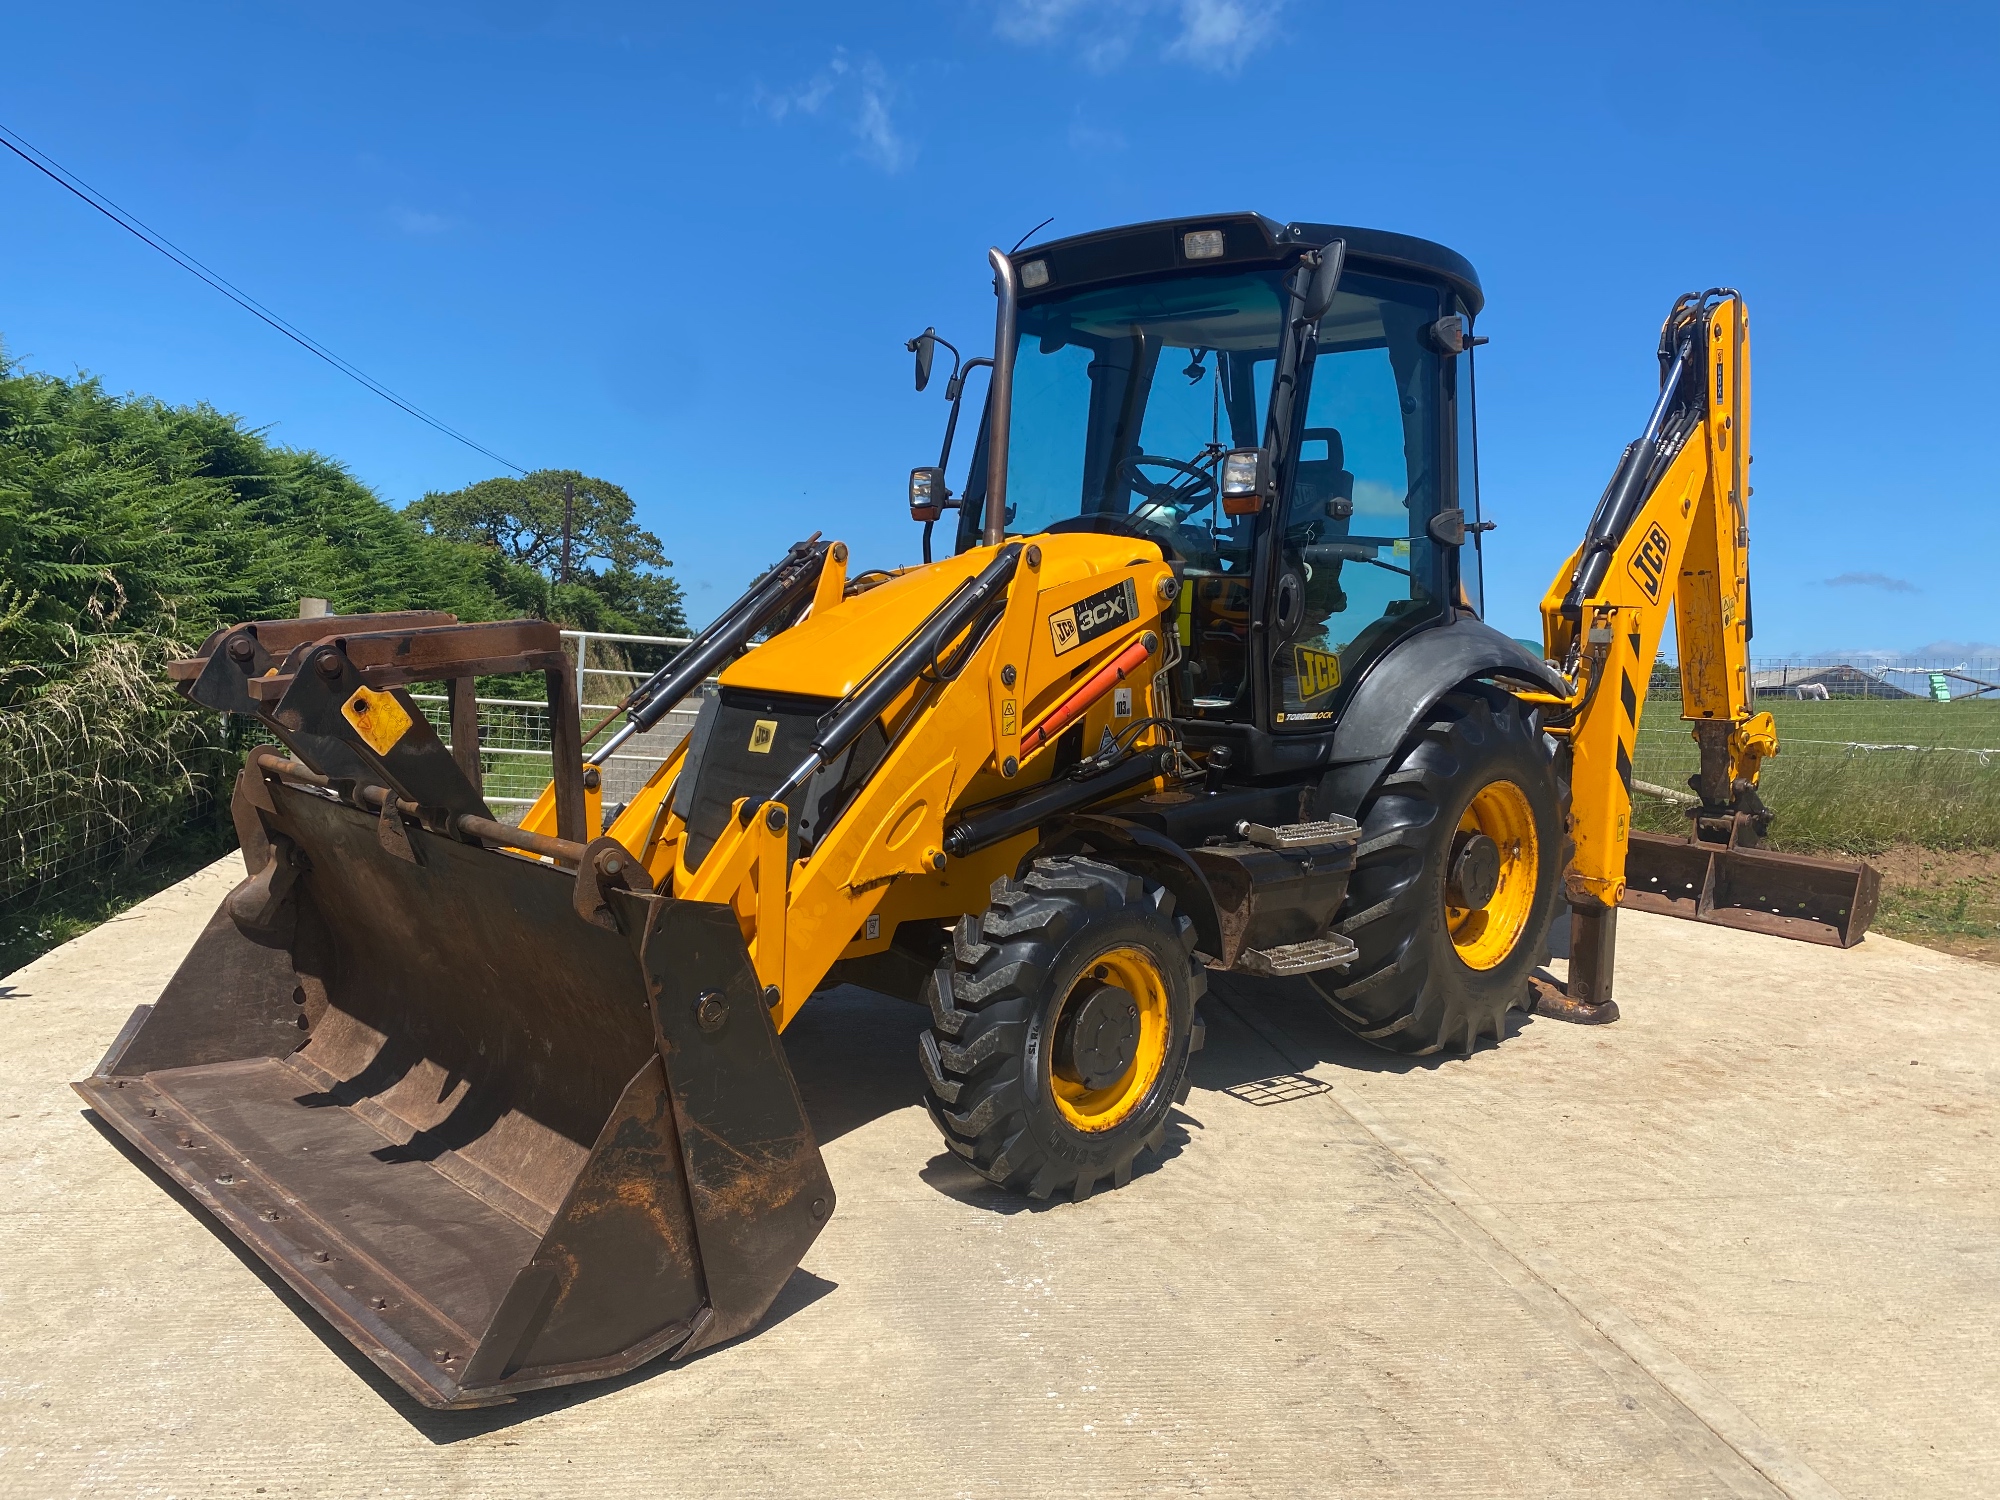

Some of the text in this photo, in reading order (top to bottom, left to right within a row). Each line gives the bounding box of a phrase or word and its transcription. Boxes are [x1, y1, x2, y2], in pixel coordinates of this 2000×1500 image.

[1294, 485, 1316, 505] JCB
[1633, 528, 1667, 597] JCB
[1056, 619, 1076, 641] JCB
[1078, 597, 1125, 632] 3CX
[1302, 651, 1339, 696] JCB
[1116, 700, 1126, 715] 103
[755, 727, 769, 743] JCB
